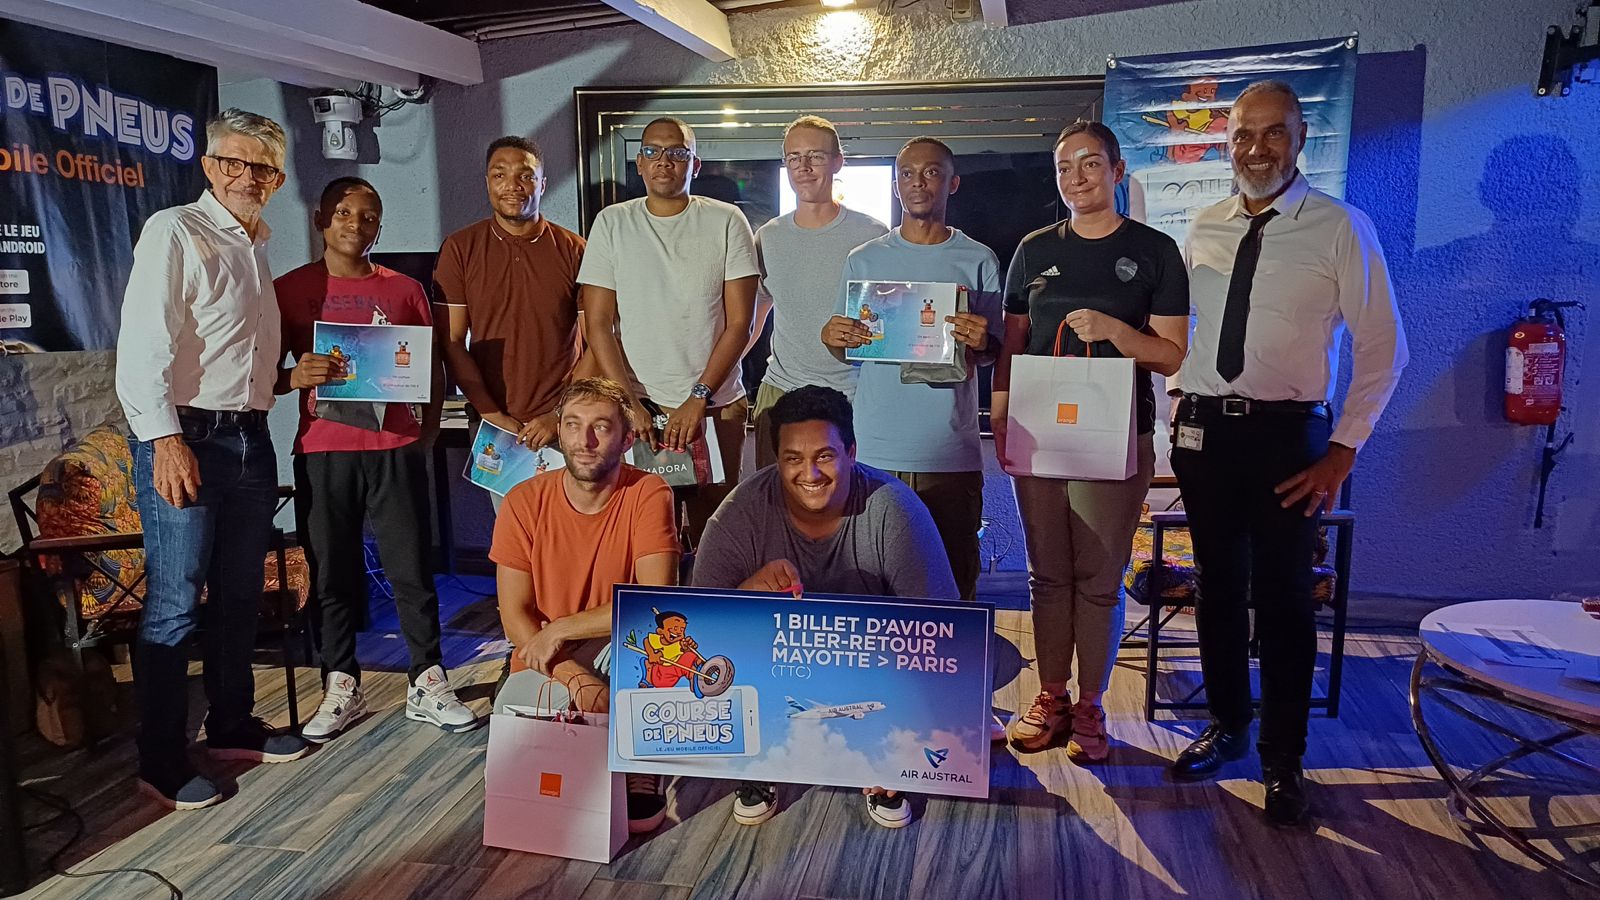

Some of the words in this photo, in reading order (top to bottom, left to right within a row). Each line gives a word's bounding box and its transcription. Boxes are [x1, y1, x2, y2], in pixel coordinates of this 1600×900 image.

[5, 76, 44, 113] DE
[48, 77, 195, 161] PNEUS
[56, 150, 145, 188] Officiel
[4, 224, 18, 237] LE
[21, 225, 40, 238] JEU
[9, 314, 28, 323] Play
[773, 613, 781, 629] 1
[788, 613, 860, 633] BILLET
[866, 617, 954, 639] D'AVION
[772, 630, 936, 655] ALLER-RETOUR
[771, 647, 871, 668] MAYOTTE
[896, 655, 958, 674] PARIS
[771, 664, 812, 680] (TTC)
[642, 700, 732, 724] COURSE
[643, 728, 662, 741] DE
[662, 723, 734, 744] PNEUS
[900, 769, 919, 779] AIR
[921, 771, 973, 783] AUSTRAL
